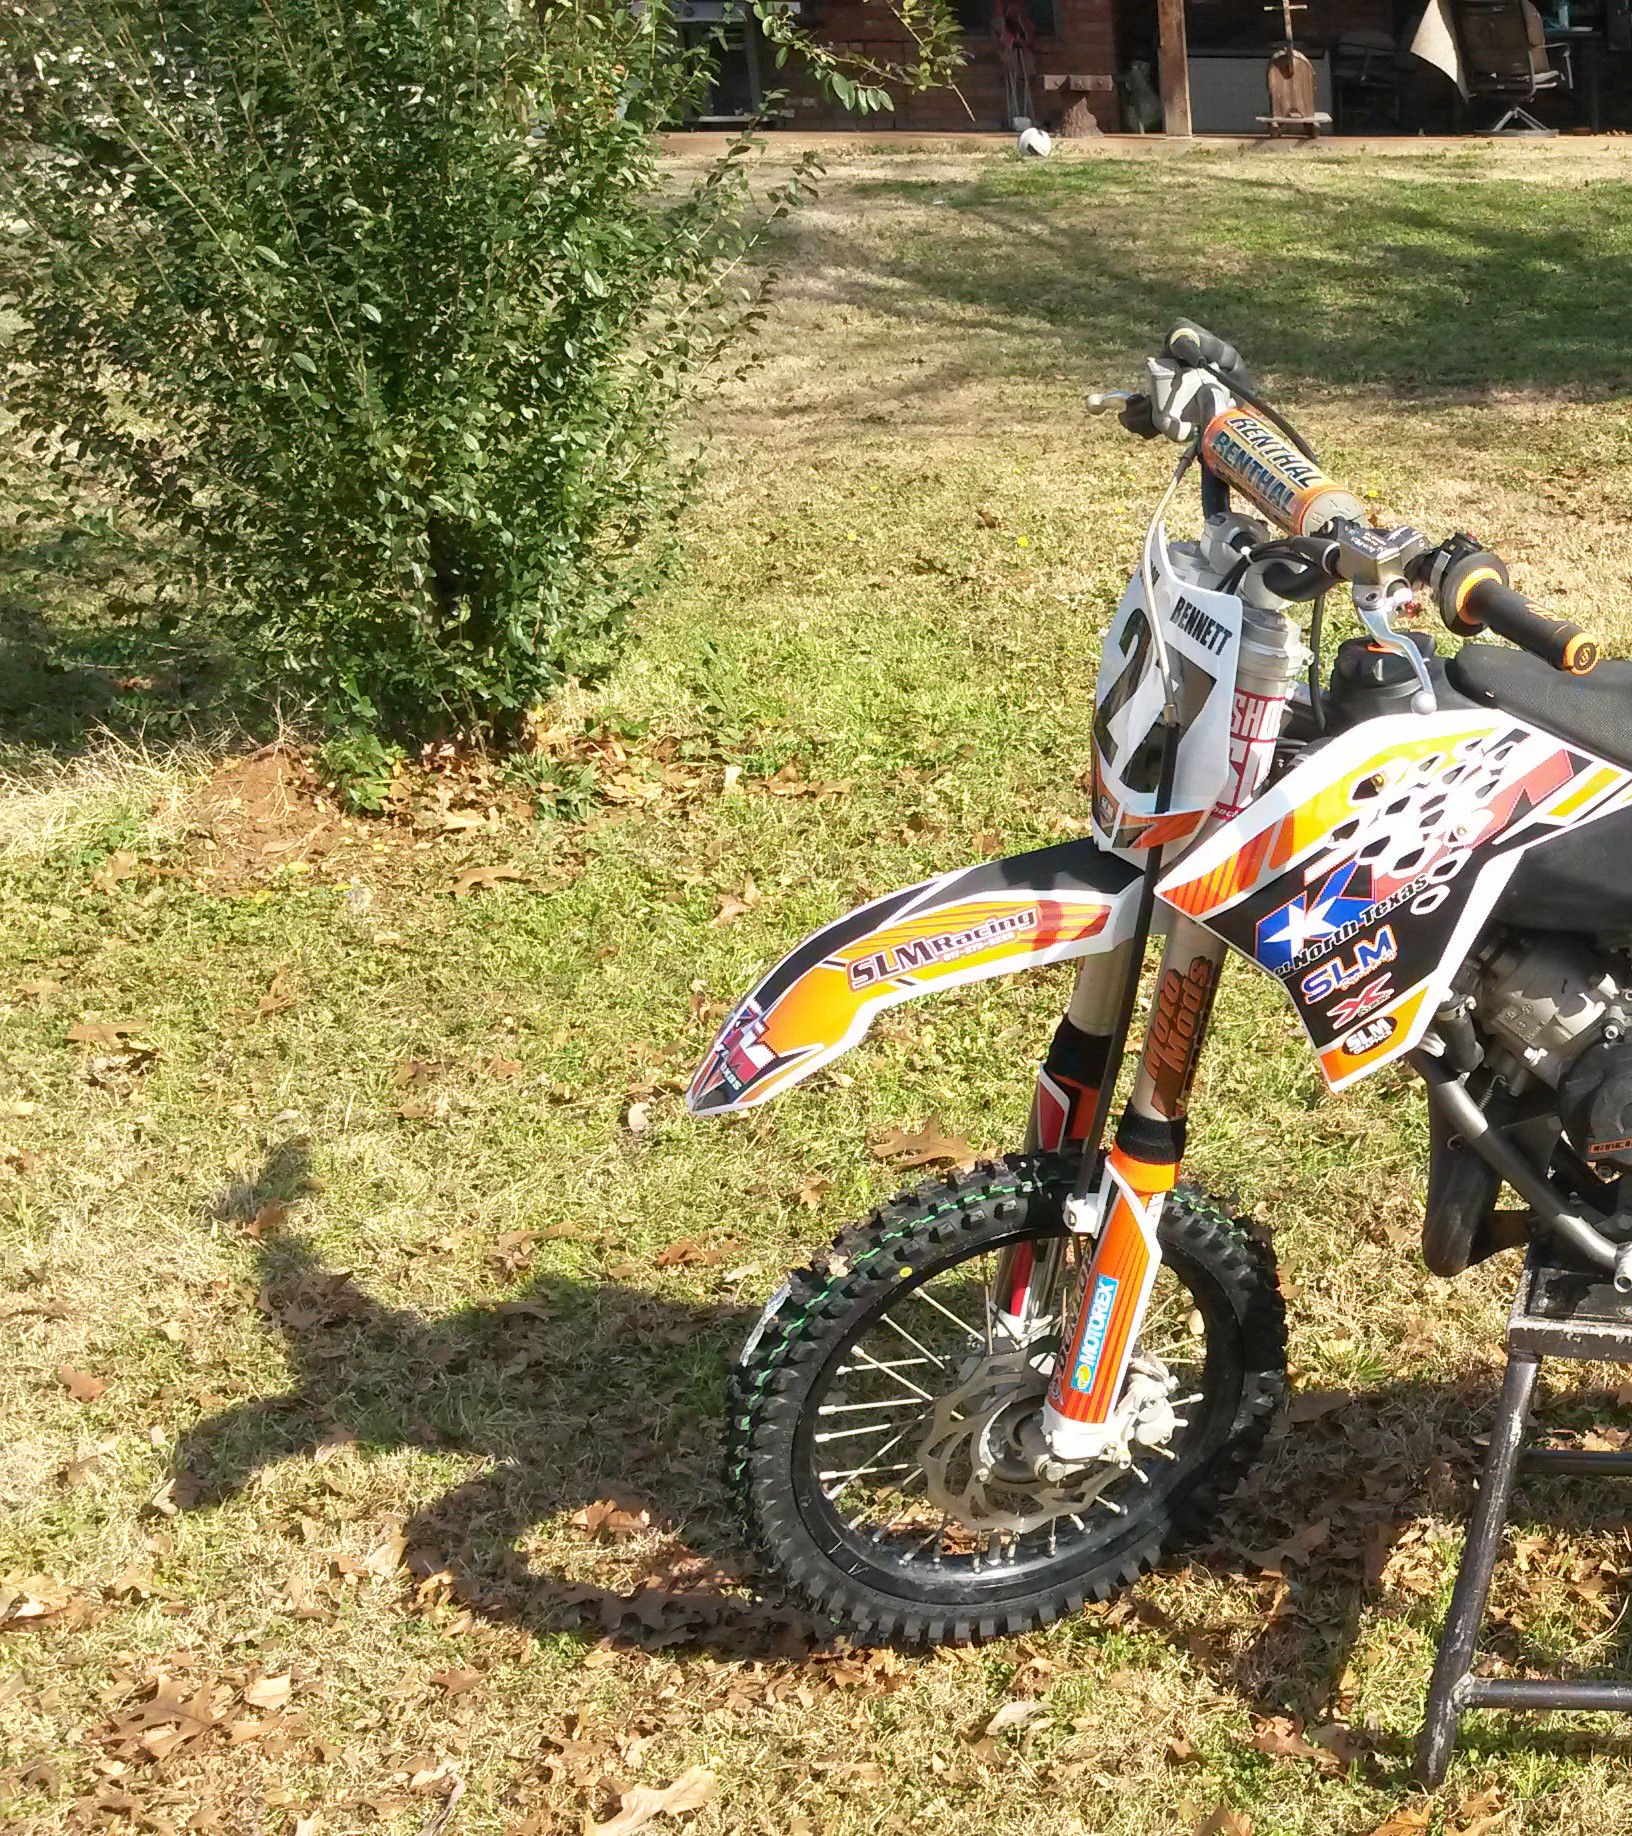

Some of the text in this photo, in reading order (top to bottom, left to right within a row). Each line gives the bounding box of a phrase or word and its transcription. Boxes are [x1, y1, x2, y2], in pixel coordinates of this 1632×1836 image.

[1210, 430, 1297, 519] RENTHAL
[1227, 417, 1323, 491] RENTHAL
[1169, 596, 1233, 656] BENNETT
[852, 938, 933, 989] SLM
[931, 908, 1038, 953] Racing
[1290, 922, 1360, 972] North
[1358, 872, 1428, 928] Texas
[1302, 926, 1395, 1004] SLM
[1143, 968, 1183, 1081] Moto
[1162, 956, 1213, 1073] Mods
[1345, 1017, 1393, 1050] SLM
[1080, 1277, 1116, 1366] MOTOREX
